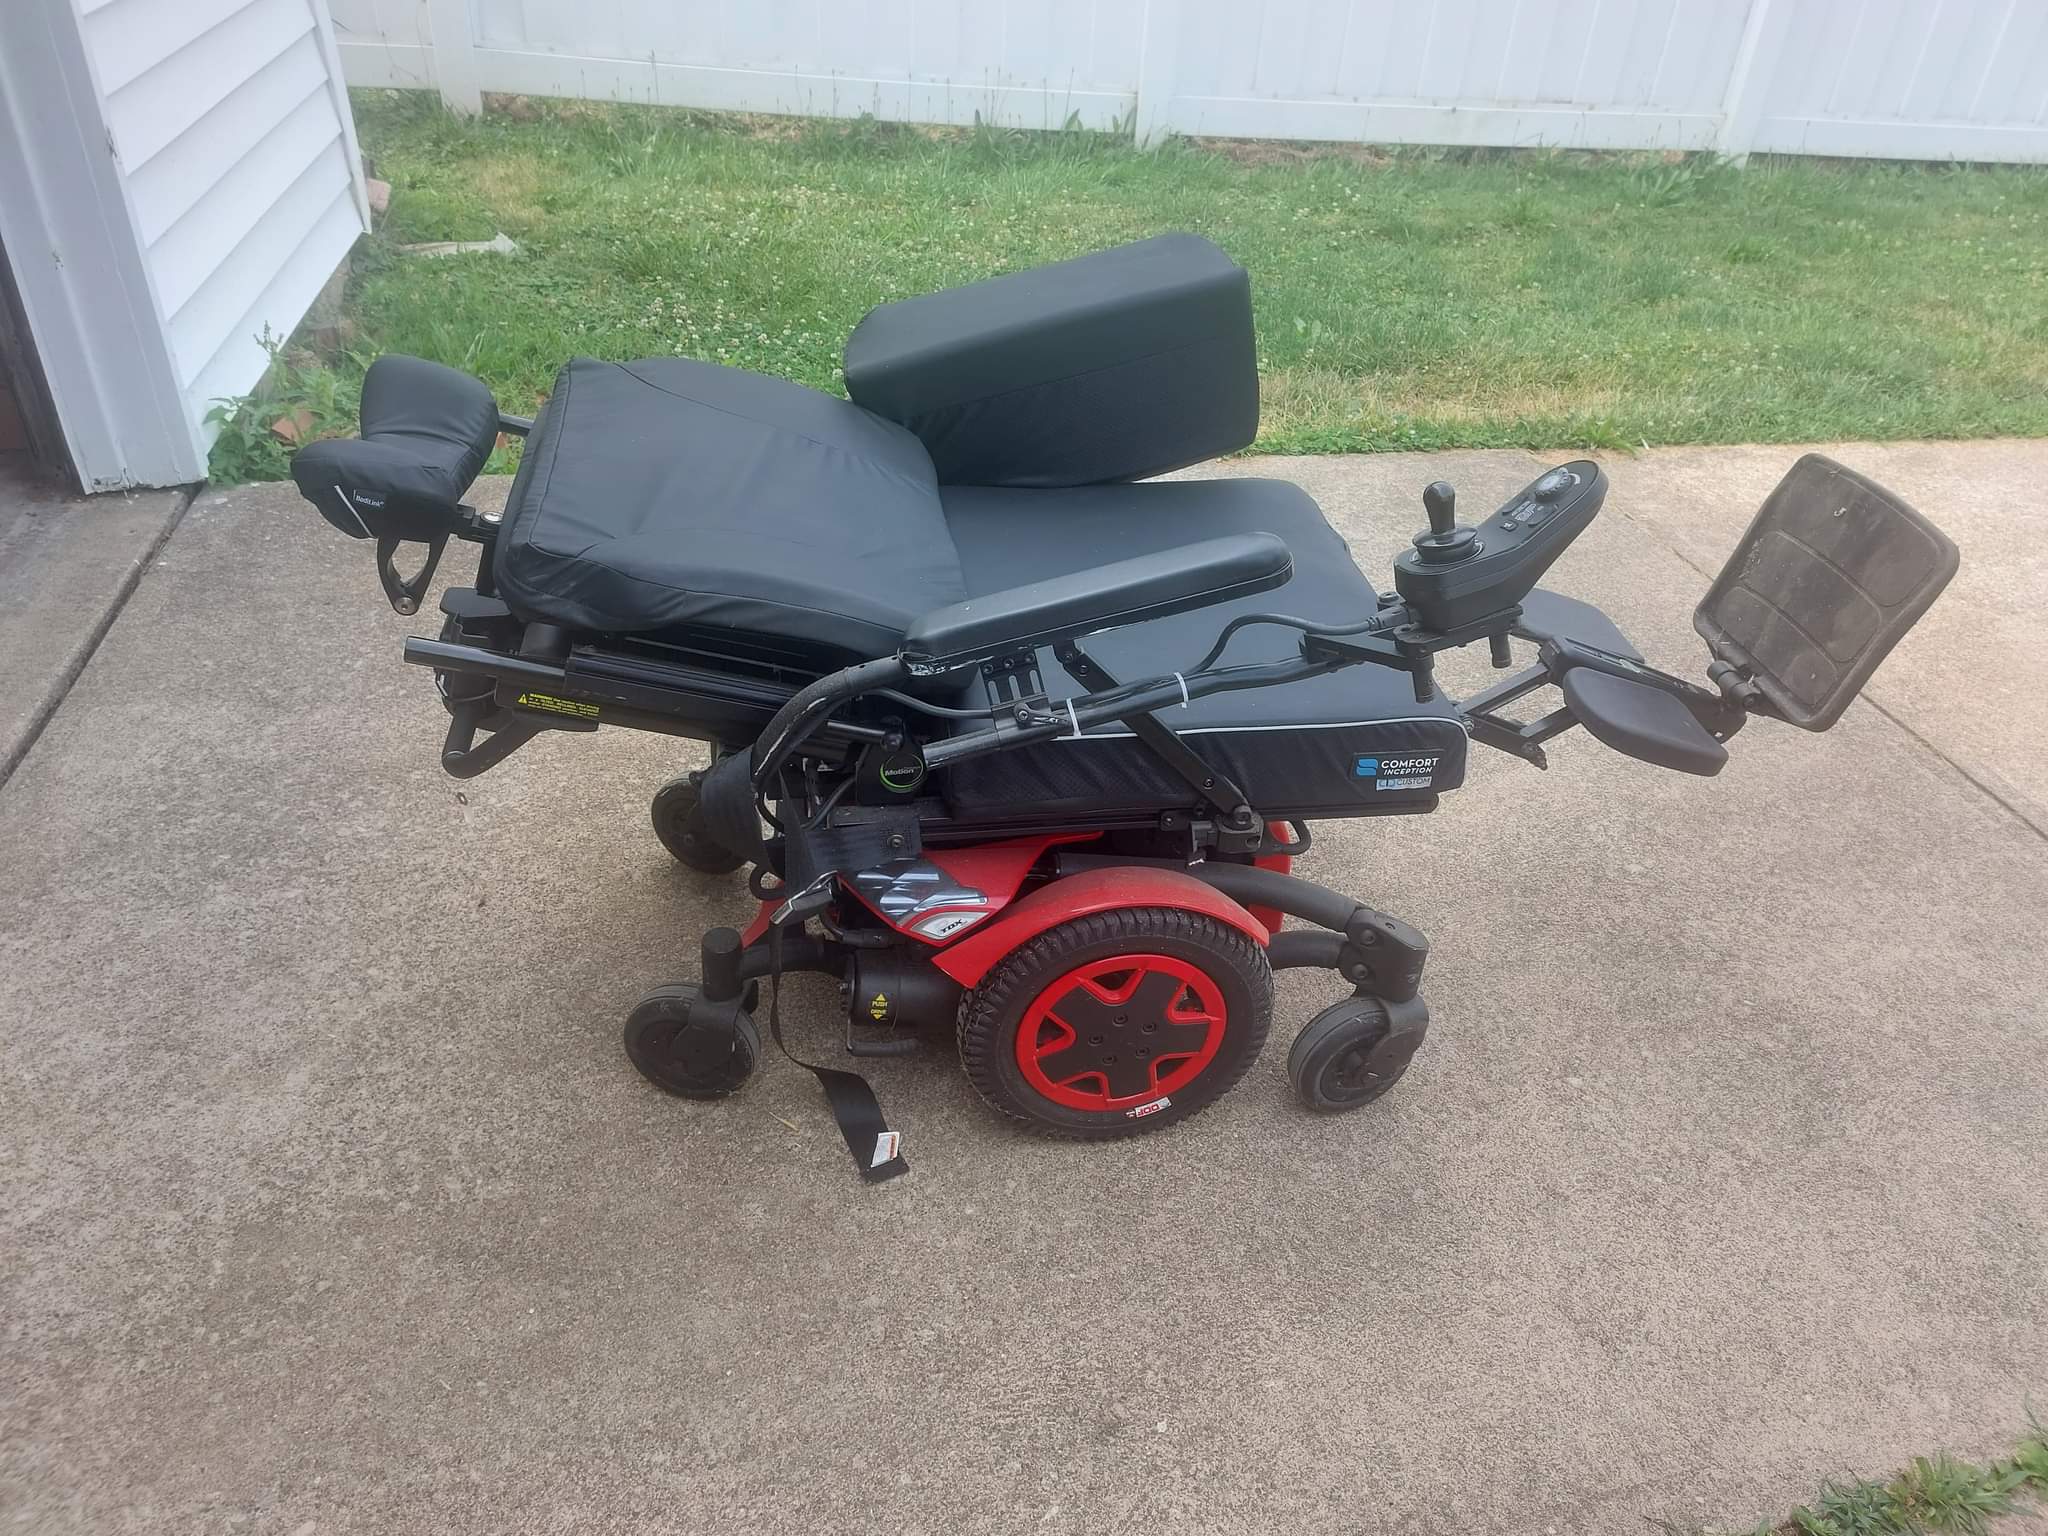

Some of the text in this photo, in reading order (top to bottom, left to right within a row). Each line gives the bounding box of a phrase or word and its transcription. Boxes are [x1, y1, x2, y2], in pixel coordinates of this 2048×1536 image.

[1381, 758, 1439, 769] COMFORT
[885, 768, 914, 776] Motion
[1384, 767, 1433, 776] INCEPTION
[1396, 776, 1431, 786] CUSTOM
[940, 918, 963, 934] TDX
